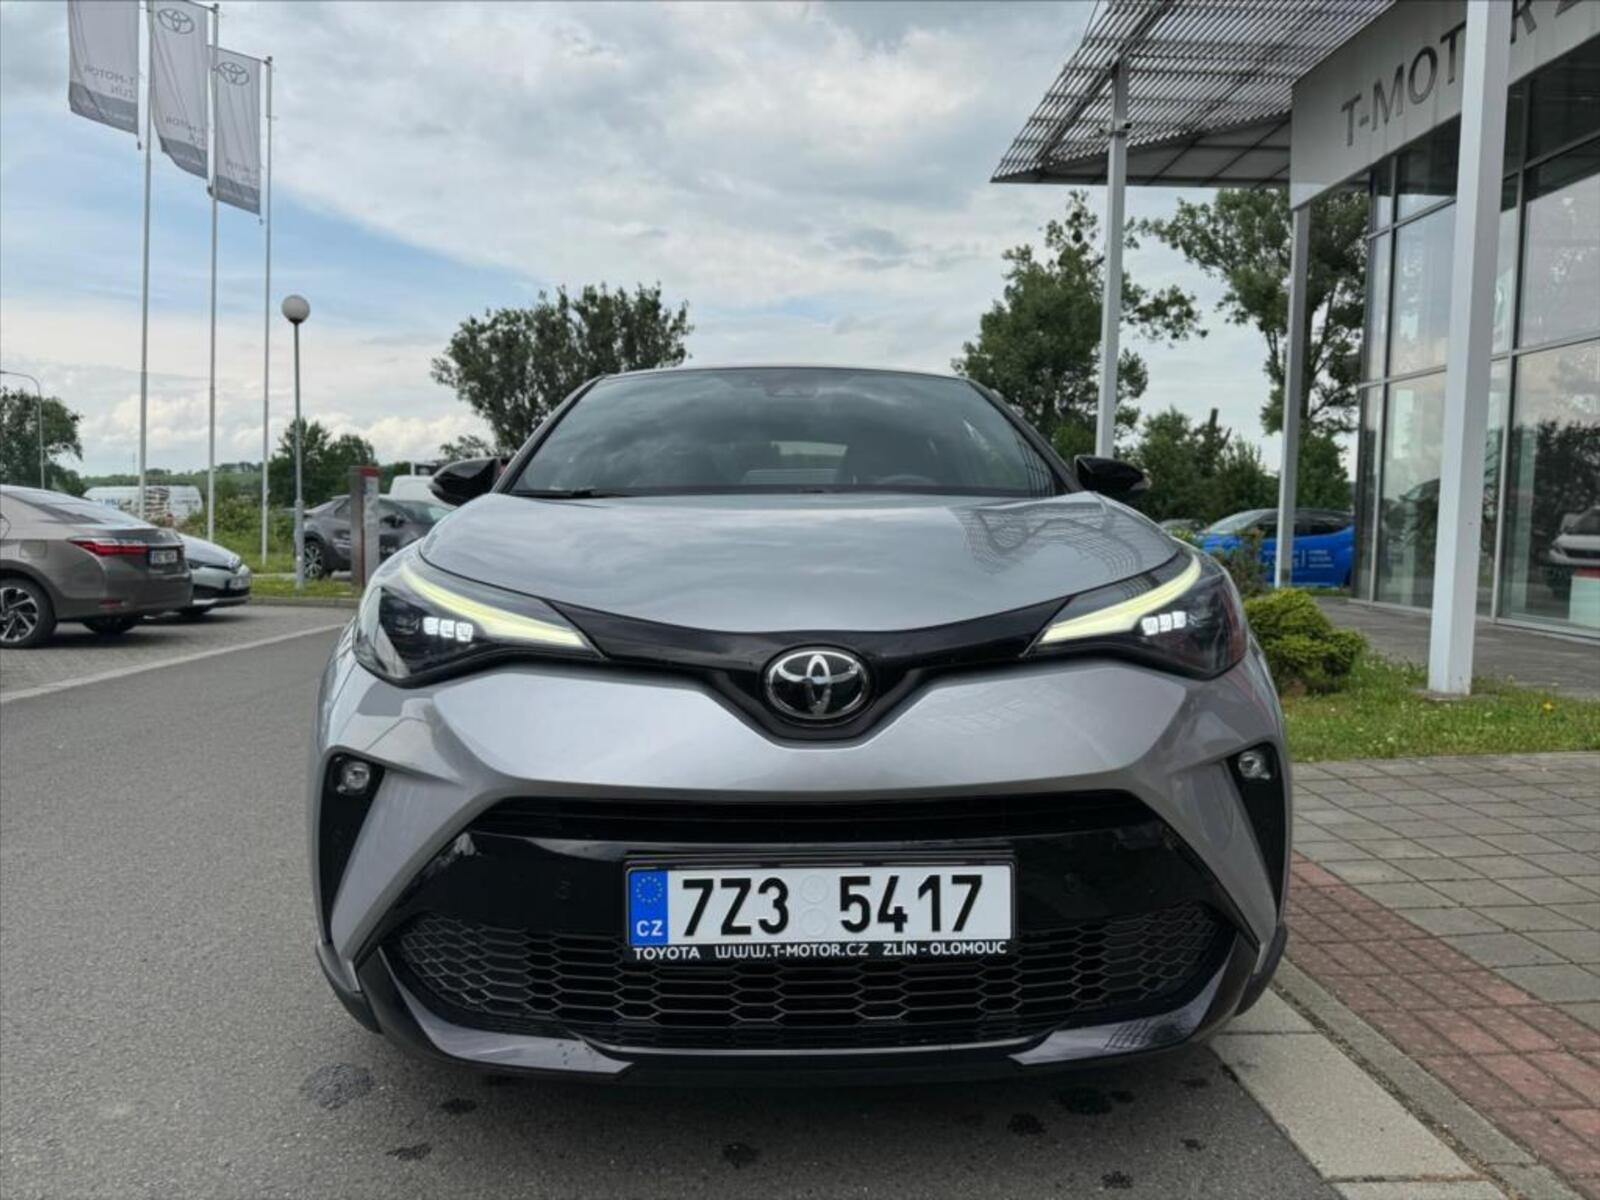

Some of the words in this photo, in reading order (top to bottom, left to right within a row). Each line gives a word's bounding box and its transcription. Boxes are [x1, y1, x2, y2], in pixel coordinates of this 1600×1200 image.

[1341, 0, 1537, 146] T-MOTR
[682, 876, 789, 937] 7Z3
[839, 874, 984, 933] 5417
[636, 920, 663, 937] CZ
[634, 946, 701, 961] TOYOTA
[714, 942, 870, 959] WWW.T-MOTOR.CZ
